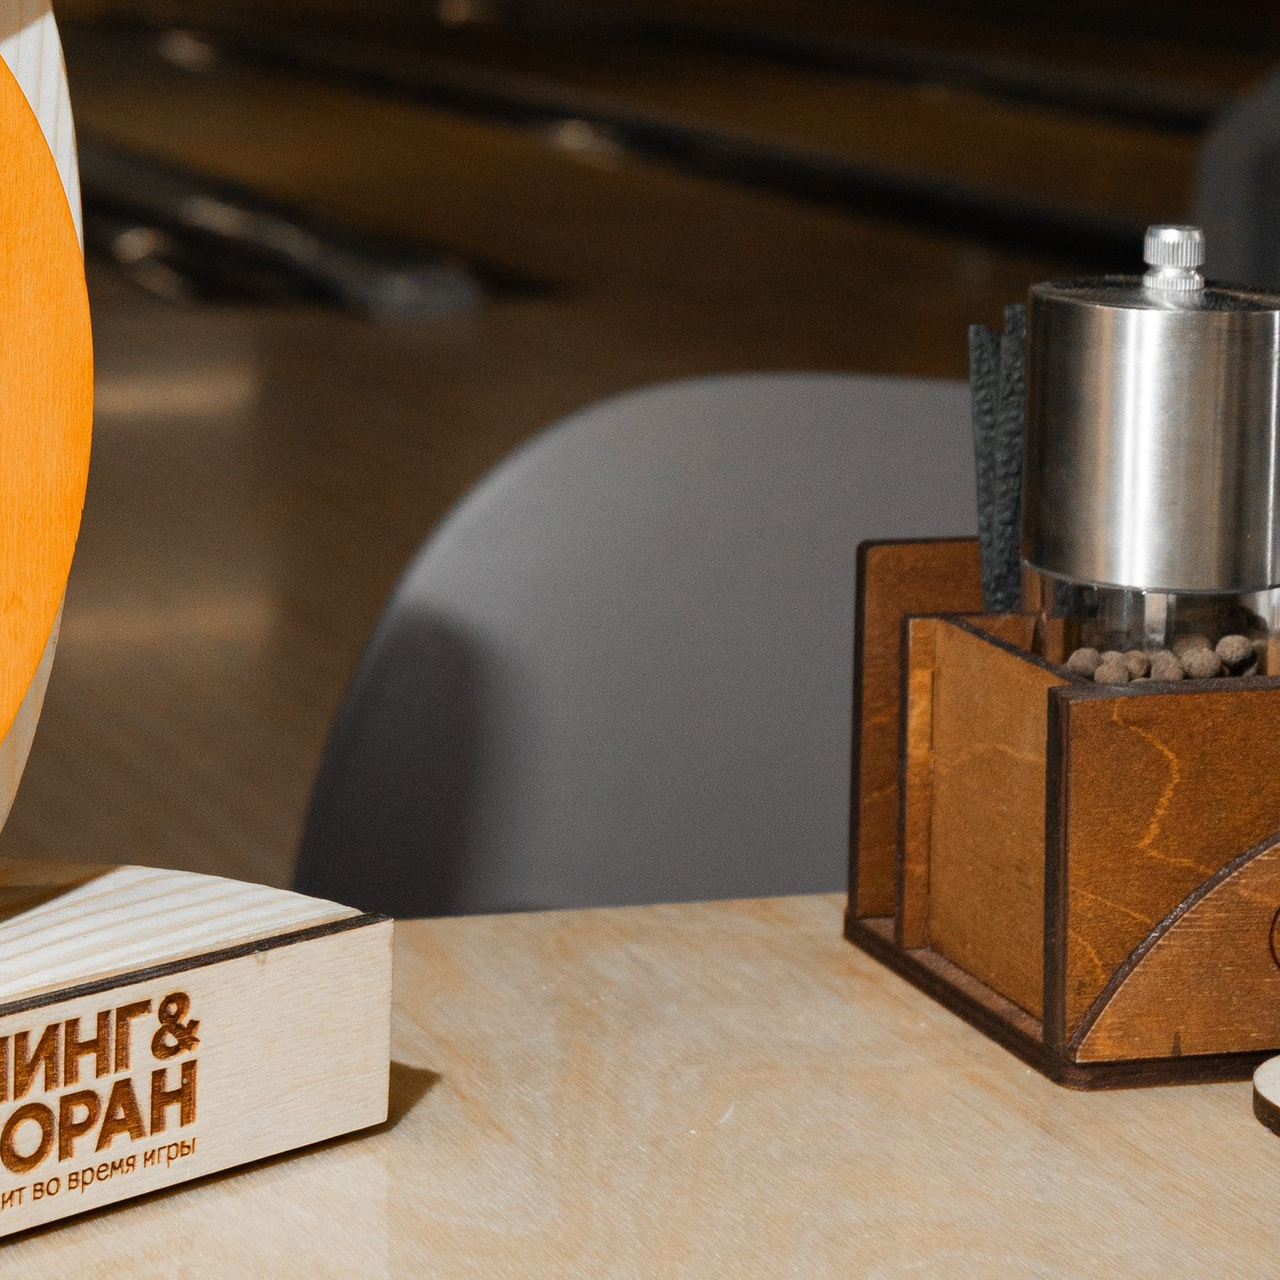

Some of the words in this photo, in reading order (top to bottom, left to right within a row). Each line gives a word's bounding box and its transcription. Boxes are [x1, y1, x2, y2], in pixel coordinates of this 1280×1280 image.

[32, 1176, 62, 1202] во
[67, 1154, 137, 1197] время
[143, 1137, 198, 1175] игры
